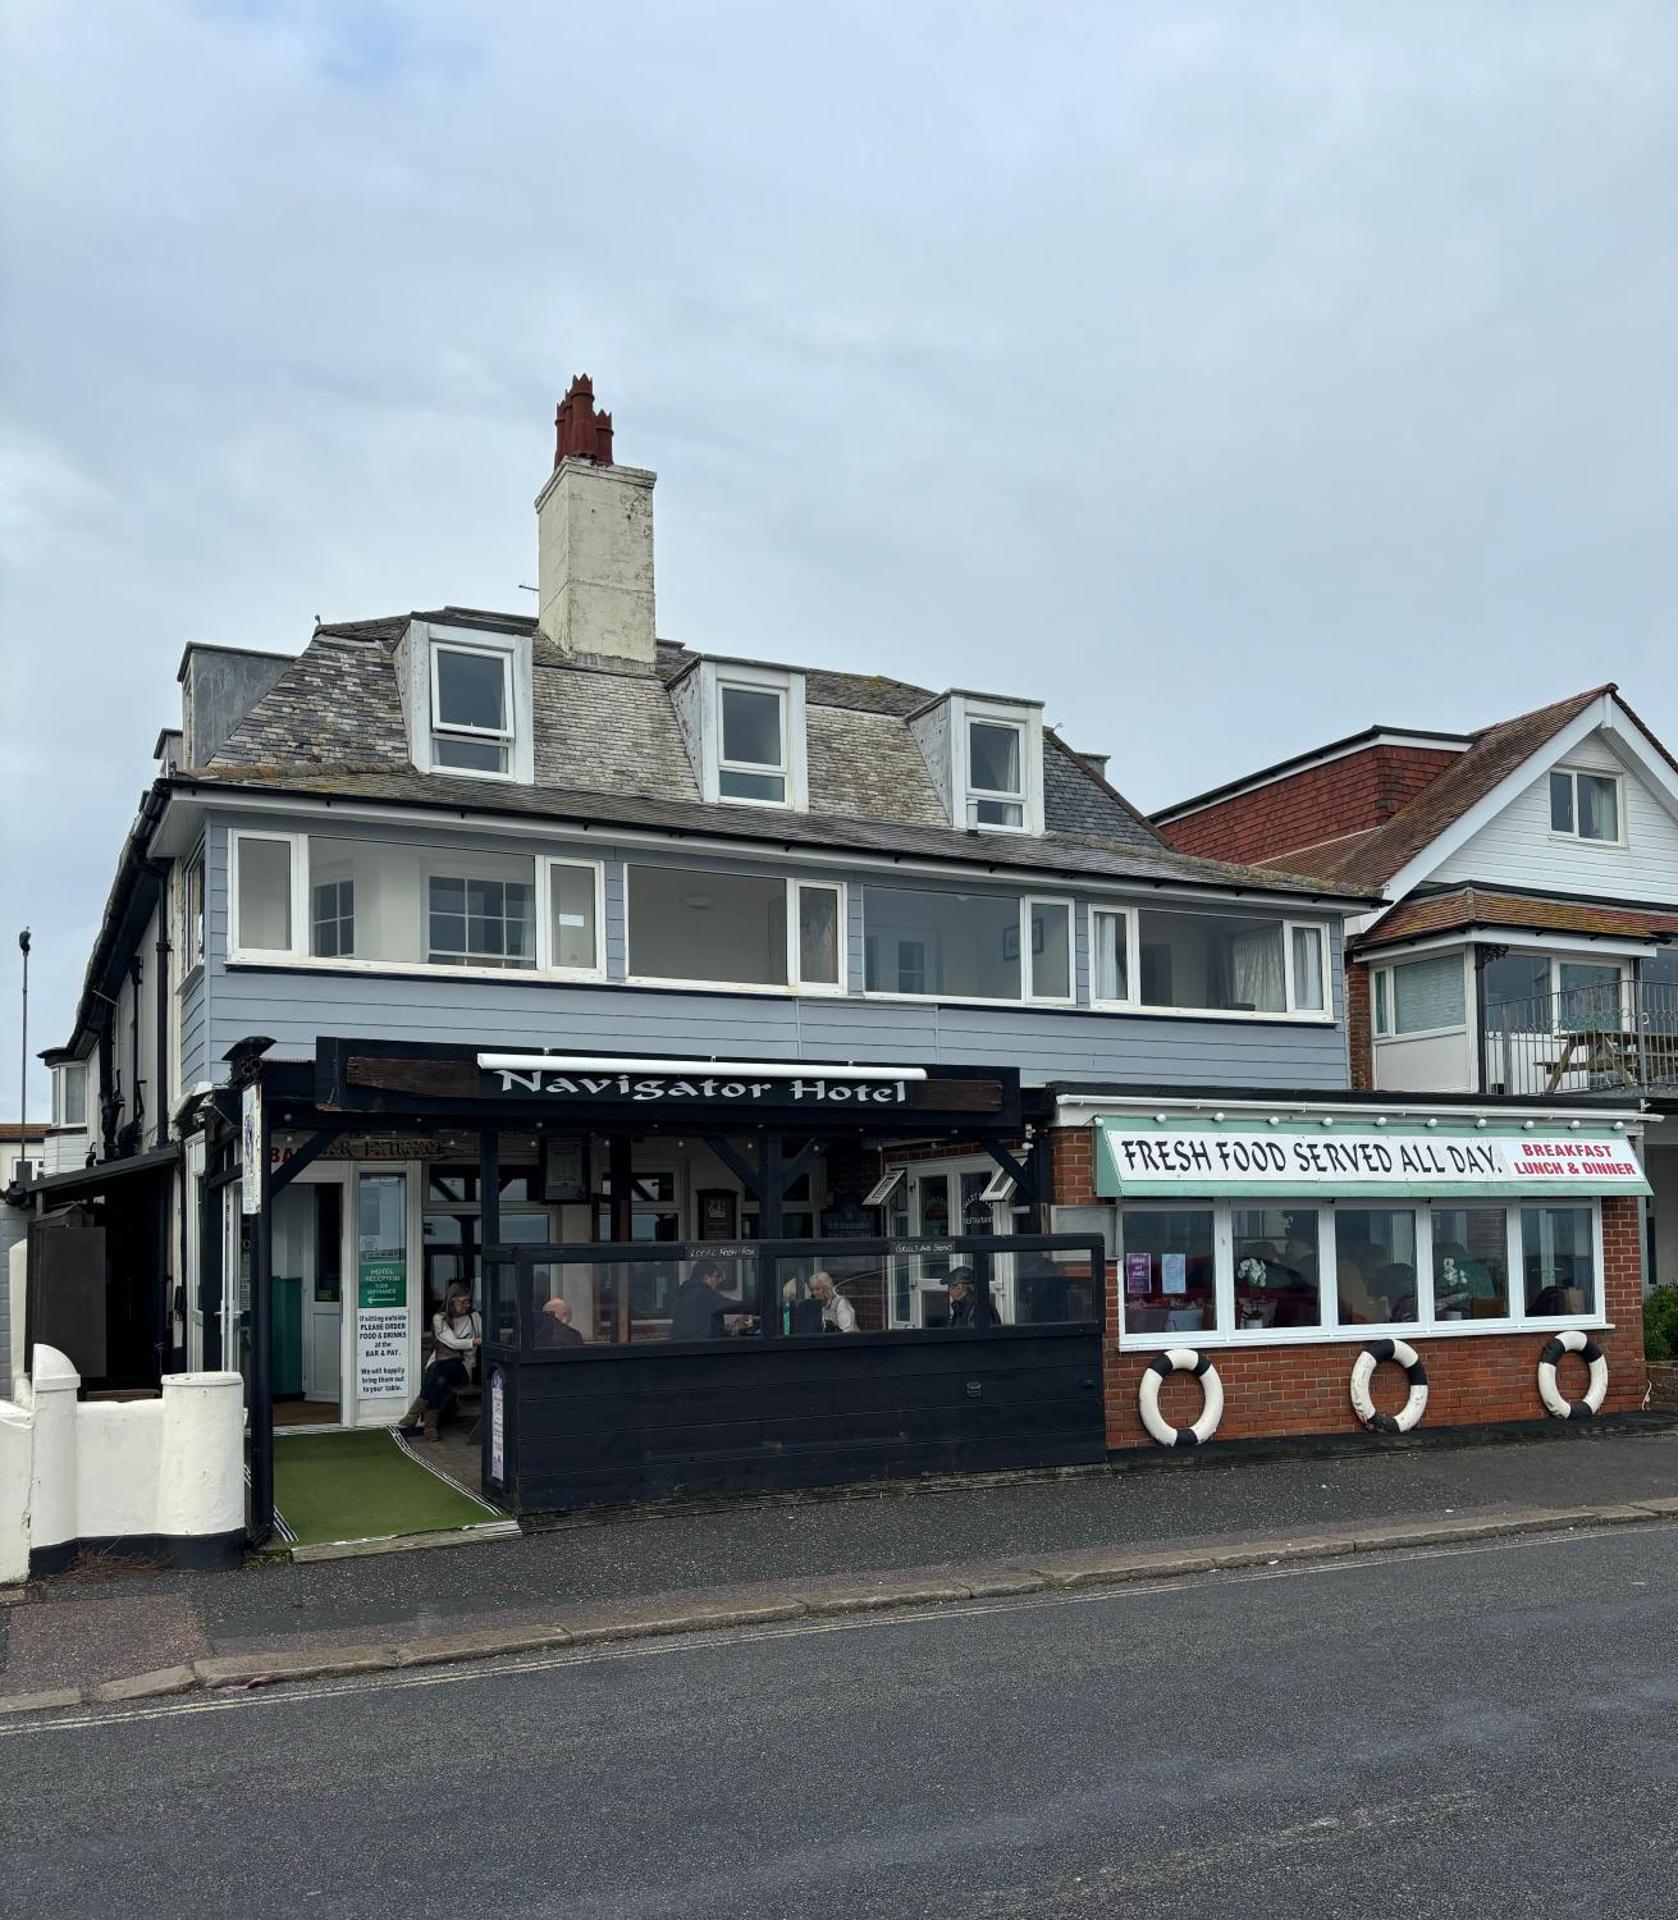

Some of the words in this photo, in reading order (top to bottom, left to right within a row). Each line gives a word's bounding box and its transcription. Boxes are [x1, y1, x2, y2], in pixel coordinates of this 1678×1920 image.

[493, 1070, 771, 1101] Navigator
[790, 1079, 906, 1103] Hotel
[270, 1147, 301, 1163] BA
[1121, 1140, 1212, 1171] FRESH
[1215, 1141, 1286, 1172] FOOD
[1293, 1142, 1392, 1173] SERVED
[1400, 1144, 1446, 1173] ALL
[1446, 1145, 1503, 1174] DAY.
[1521, 1143, 1613, 1158] BREAKFAST
[1513, 1161, 1564, 1175] LUNCH
[1567, 1162, 1580, 1175] &
[1581, 1162, 1637, 1176] DINNER
[360, 1323, 384, 1331] PLEASE
[384, 1322, 406, 1330] ORDER
[383, 1331, 407, 1339] DRINKS
[383, 1367, 405, 1376] happily
